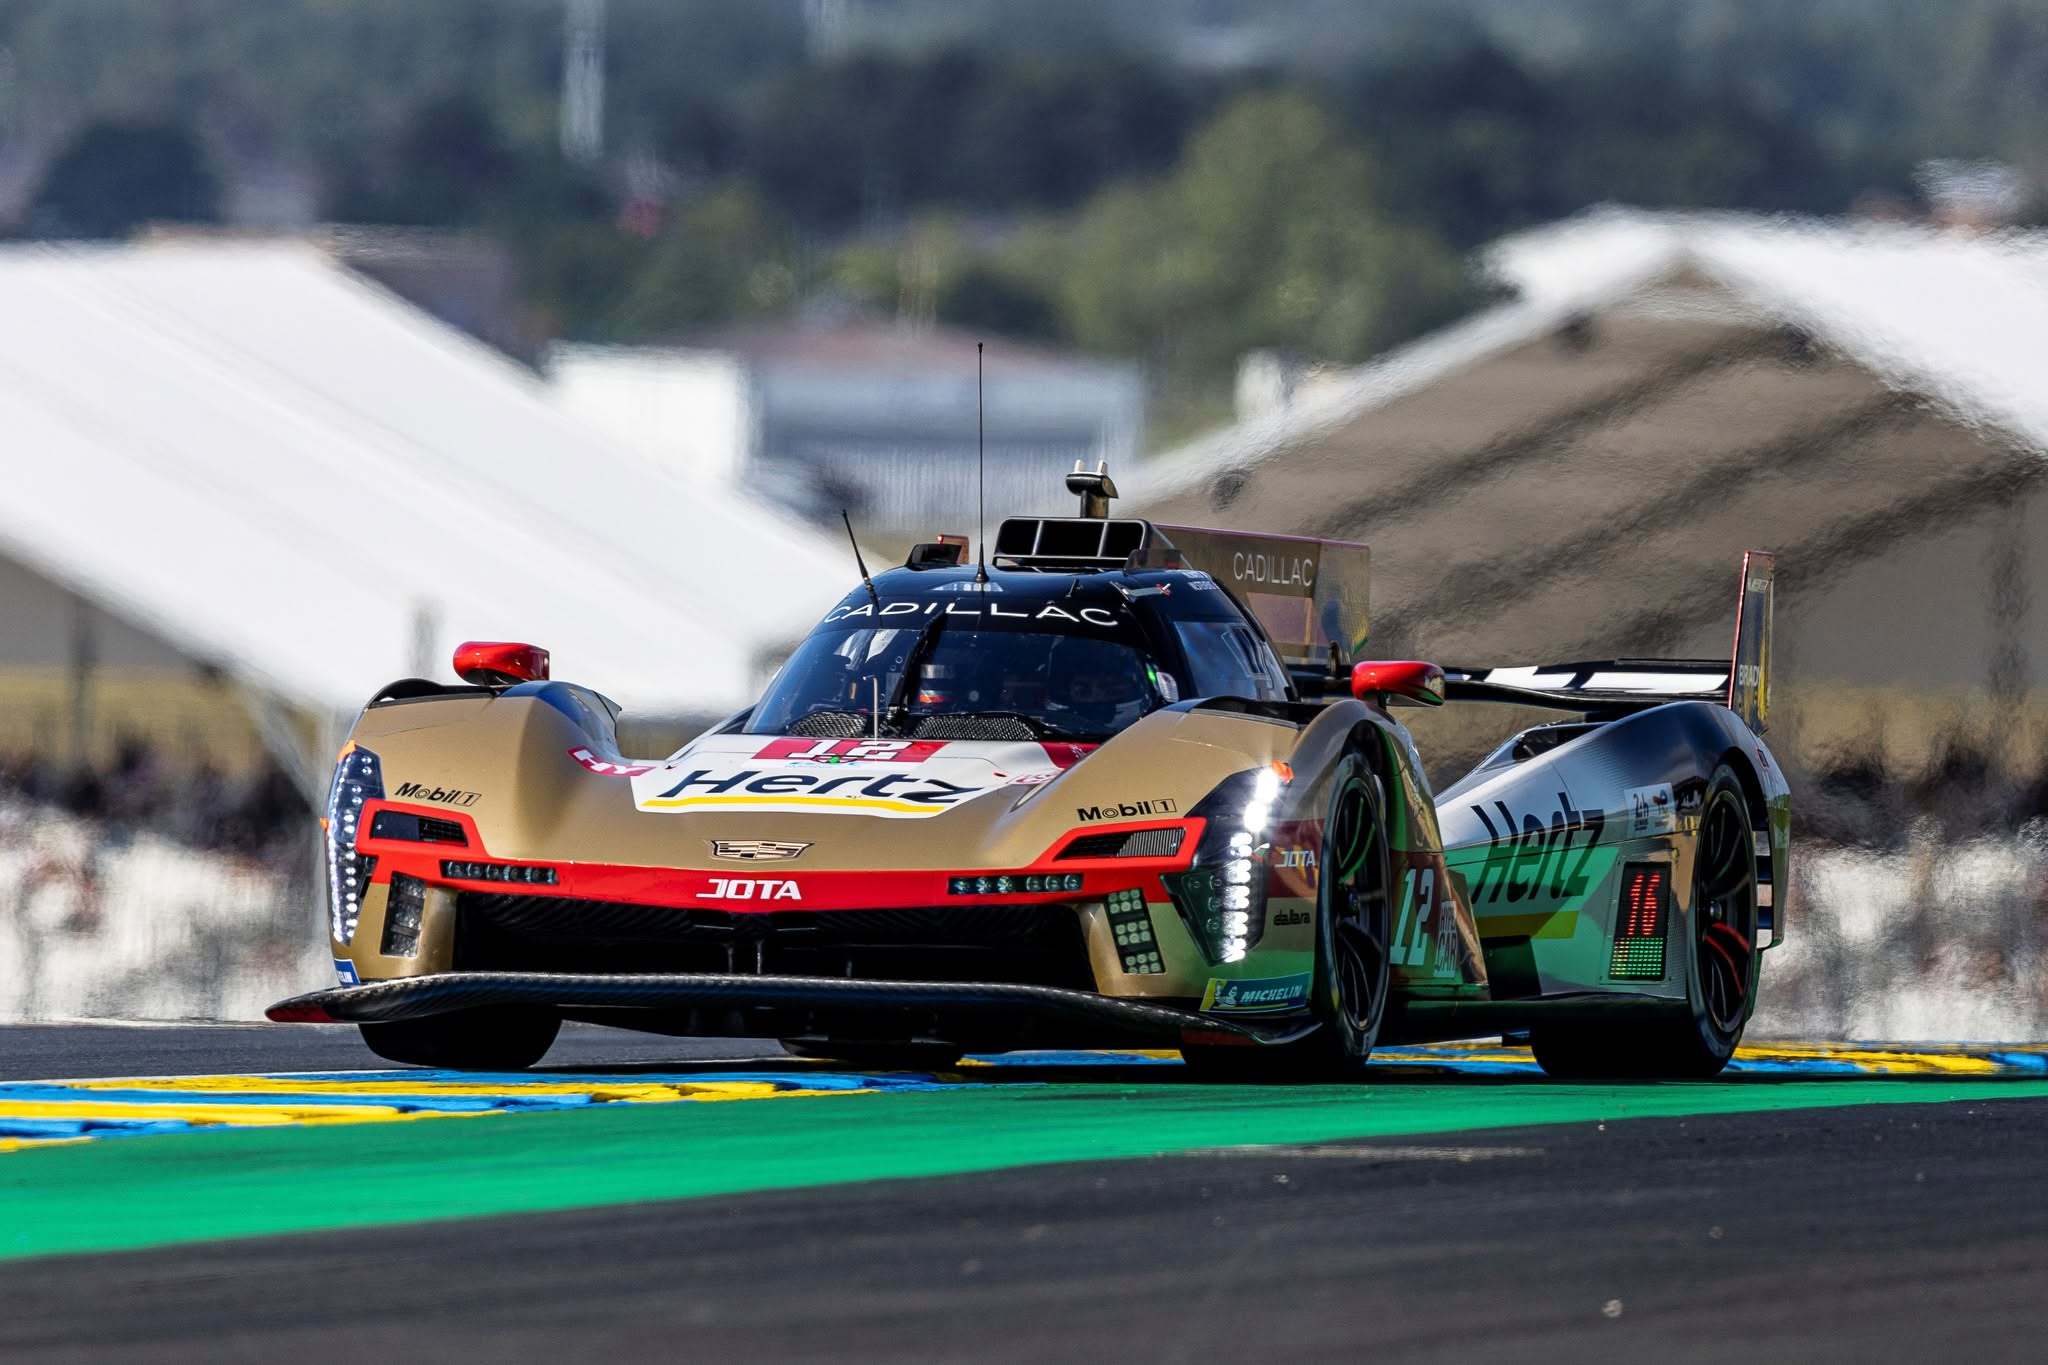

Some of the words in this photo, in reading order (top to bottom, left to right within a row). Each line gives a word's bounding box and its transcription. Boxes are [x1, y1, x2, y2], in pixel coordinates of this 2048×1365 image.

[1233, 552, 1312, 586] CADILLAC
[823, 602, 1118, 626] CADILLAC
[786, 739, 914, 760] 12
[394, 782, 461, 804] Mobil
[656, 769, 986, 804] Hertz
[1076, 800, 1152, 821] Mobil
[1274, 850, 1317, 868] JOTA
[1470, 791, 1605, 905] Hertz
[695, 878, 802, 900] JOTA
[1389, 867, 1435, 966] 12
[1239, 984, 1303, 1004] MICHELIN
